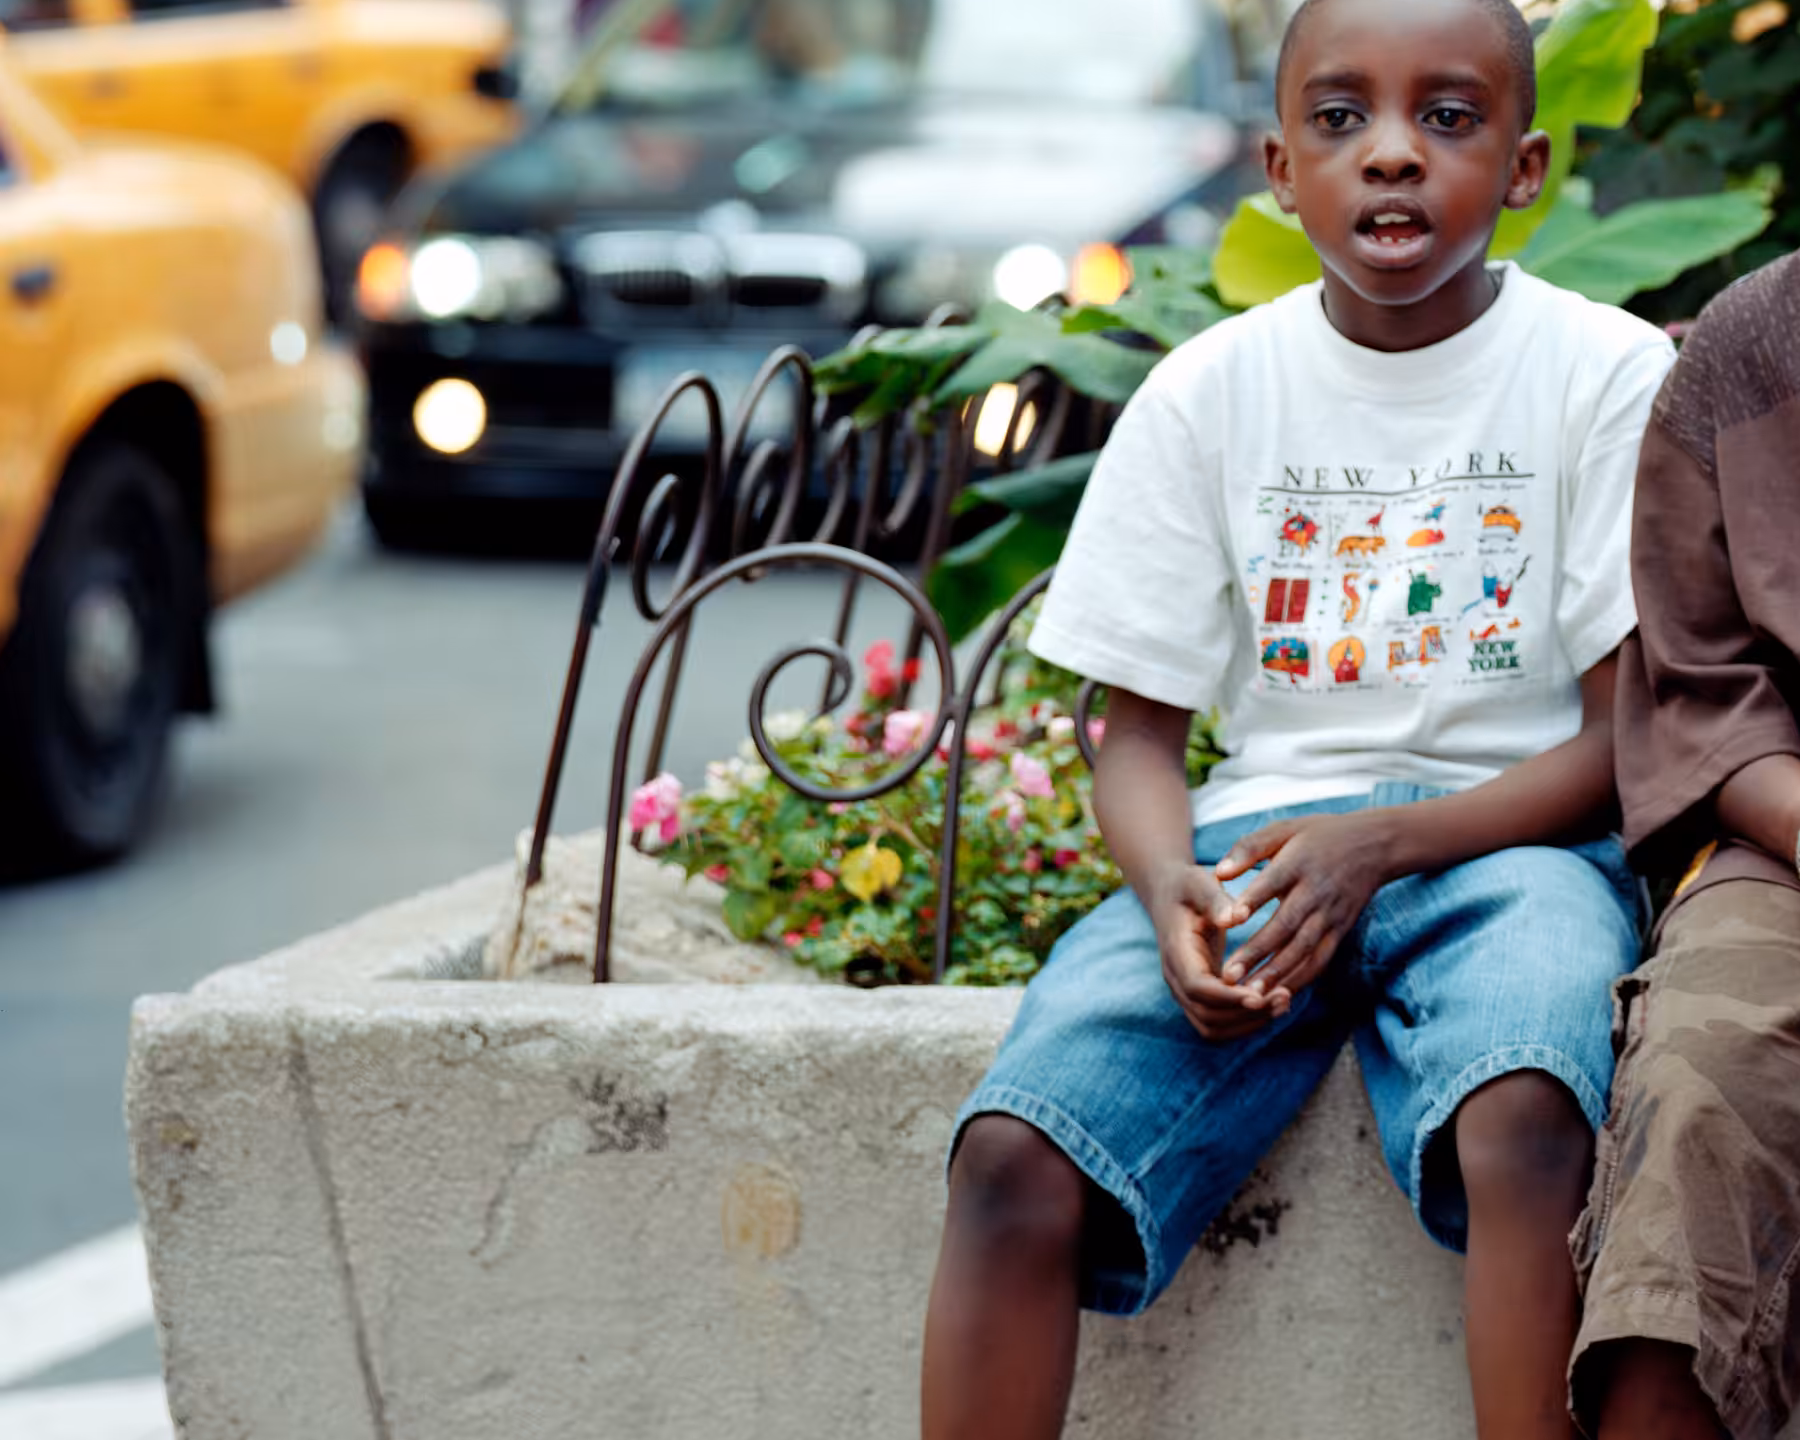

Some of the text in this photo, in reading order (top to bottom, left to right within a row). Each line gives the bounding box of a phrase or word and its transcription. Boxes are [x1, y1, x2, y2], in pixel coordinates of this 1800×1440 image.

[1282, 451, 1517, 489] NEW YORK
[1474, 639, 1518, 656] NEW
[1467, 655, 1520, 673] YORK
